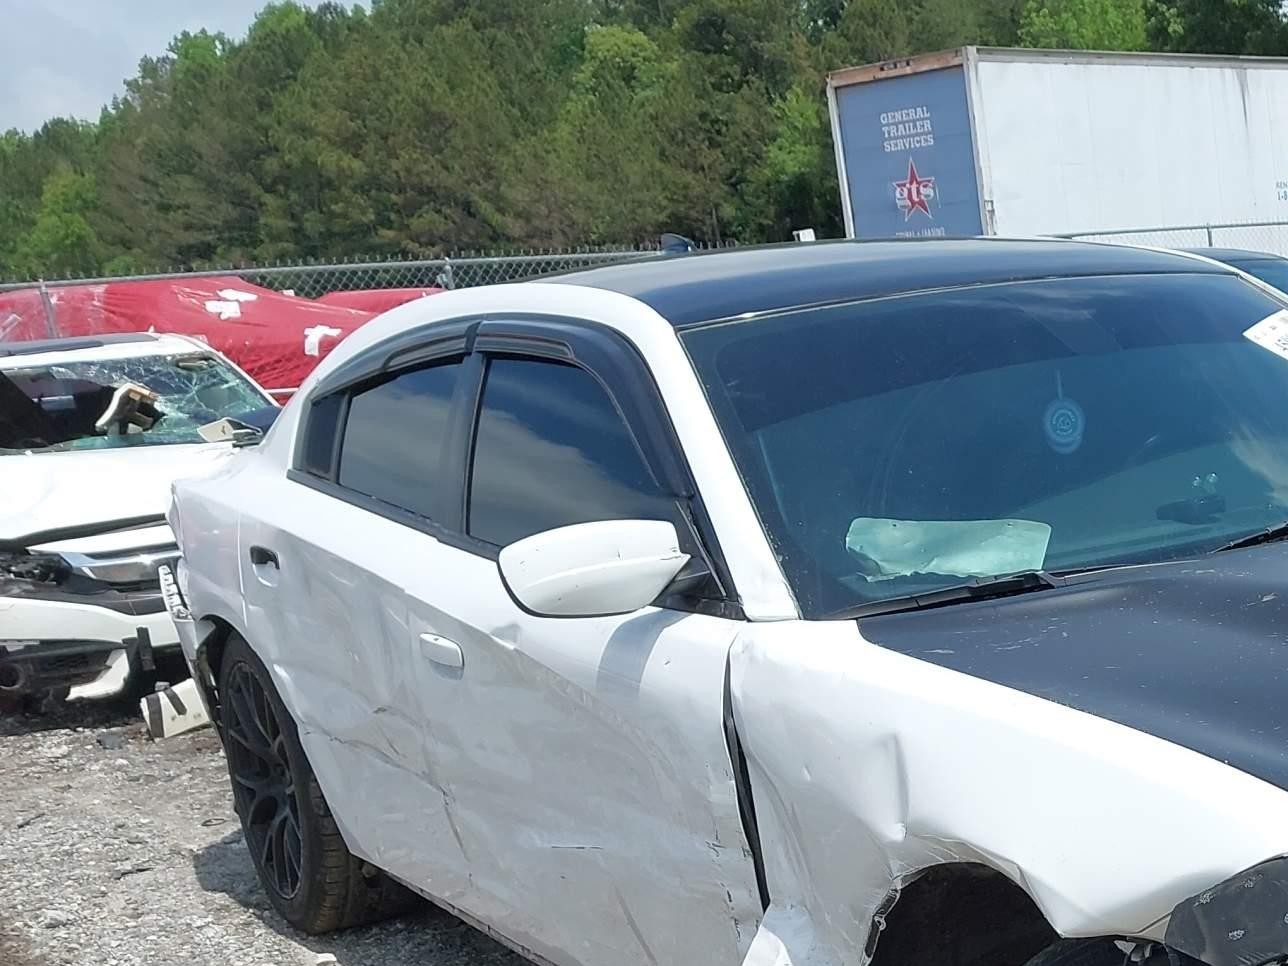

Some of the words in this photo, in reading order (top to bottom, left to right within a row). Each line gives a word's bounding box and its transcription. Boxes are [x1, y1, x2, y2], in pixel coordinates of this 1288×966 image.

[880, 106, 930, 124] GENERAL
[882, 120, 932, 138] TRAILER
[884, 134, 934, 152] SERVICES
[895, 180, 934, 210] gts
